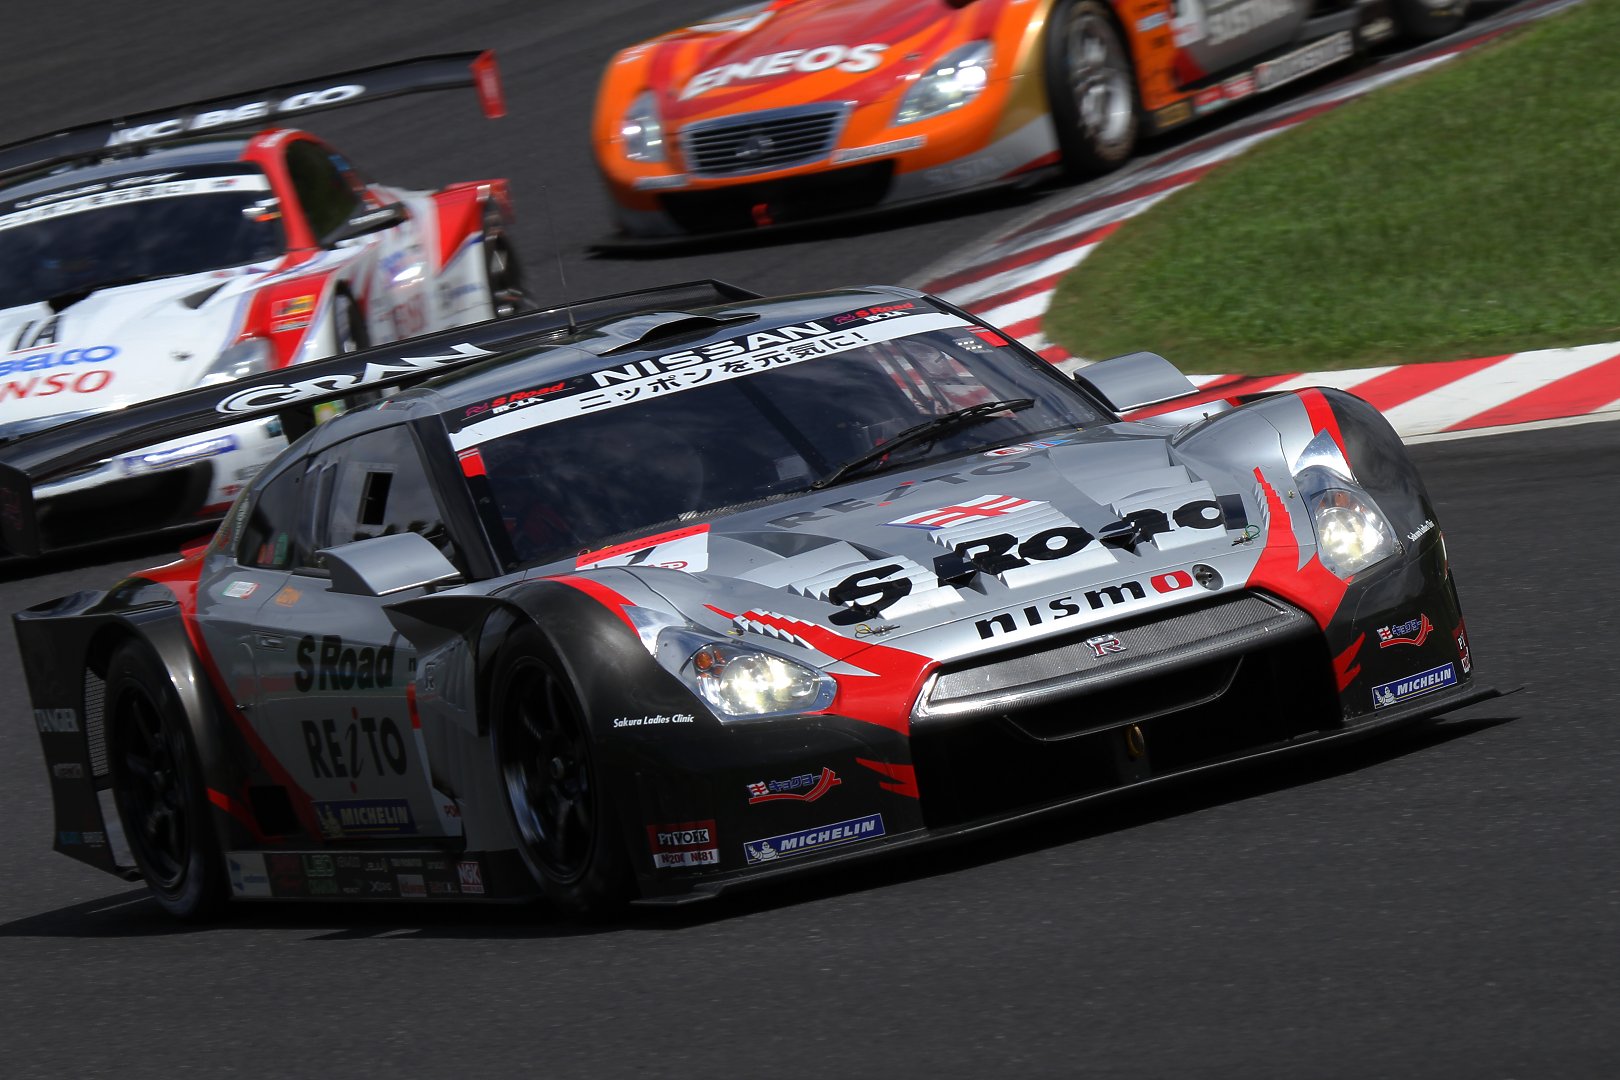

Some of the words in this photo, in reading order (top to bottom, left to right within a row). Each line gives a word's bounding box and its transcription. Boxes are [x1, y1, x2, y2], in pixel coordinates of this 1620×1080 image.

[678, 43, 889, 100] ENEOS
[591, 322, 833, 387] NISSAN
[975, 570, 1193, 640] nismo
[1396, 667, 1452, 696] MICHELIN
[613, 717, 642, 728] Sakura
[643, 714, 670, 725] Ladies
[672, 713, 695, 723] Clinic
[340, 806, 409, 826] MICHELIN
[780, 819, 876, 851] MICHELIN
[458, 862, 481, 884] NGK
